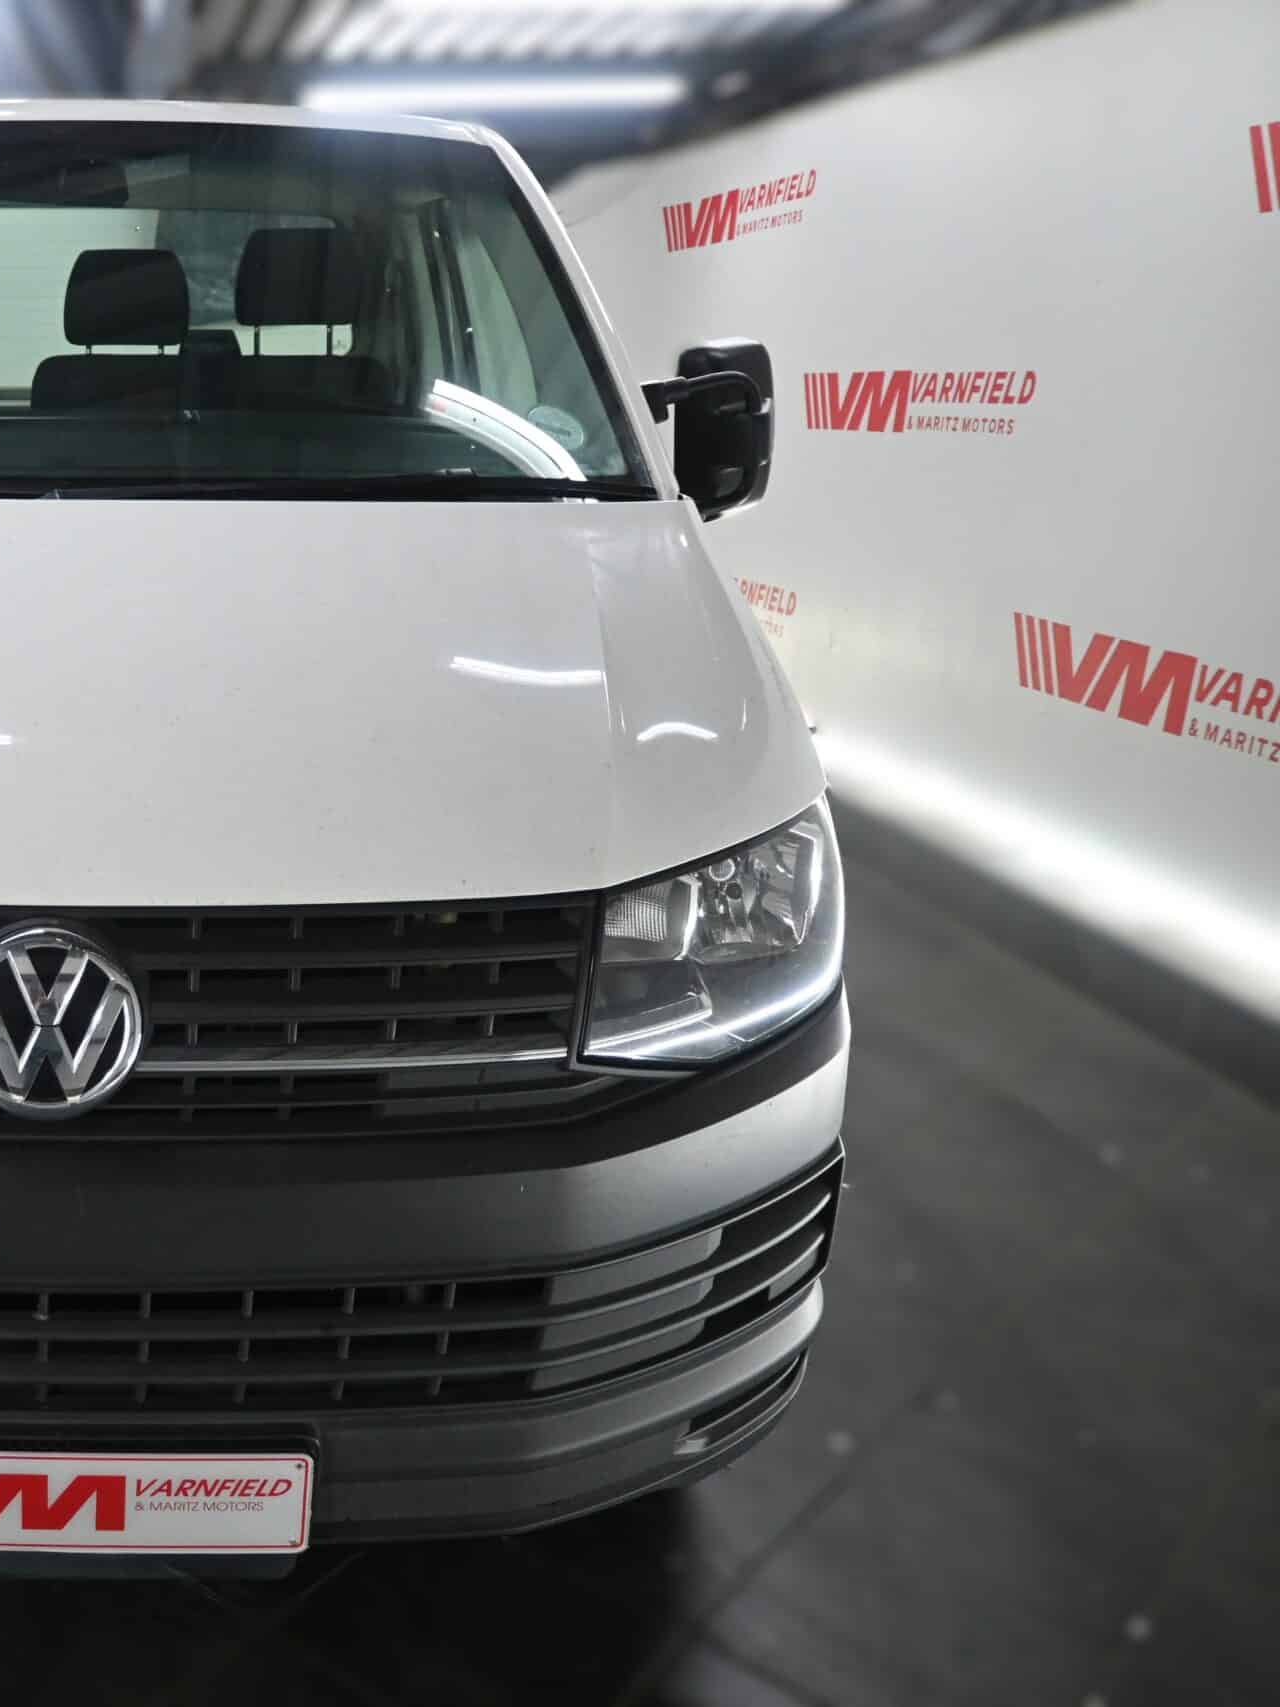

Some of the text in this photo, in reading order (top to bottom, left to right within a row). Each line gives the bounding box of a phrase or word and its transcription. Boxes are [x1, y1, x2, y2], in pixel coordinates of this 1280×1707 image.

[739, 168, 817, 214] VARNFIELD
[683, 188, 740, 249] VM
[770, 209, 804, 229] MOTORS
[827, 370, 912, 432] VM
[910, 370, 1037, 404] VARNFIELD
[917, 416, 959, 432] MARITZ
[962, 417, 1015, 435] MOTORS
[734, 577, 797, 616] RNFIELD
[1052, 622, 1198, 736] VM
[1188, 718, 1280, 763] & MARITZ
[134, 1501, 264, 1512] & MARITZ MOTORS
[135, 1478, 293, 1497] VARNFIELD
